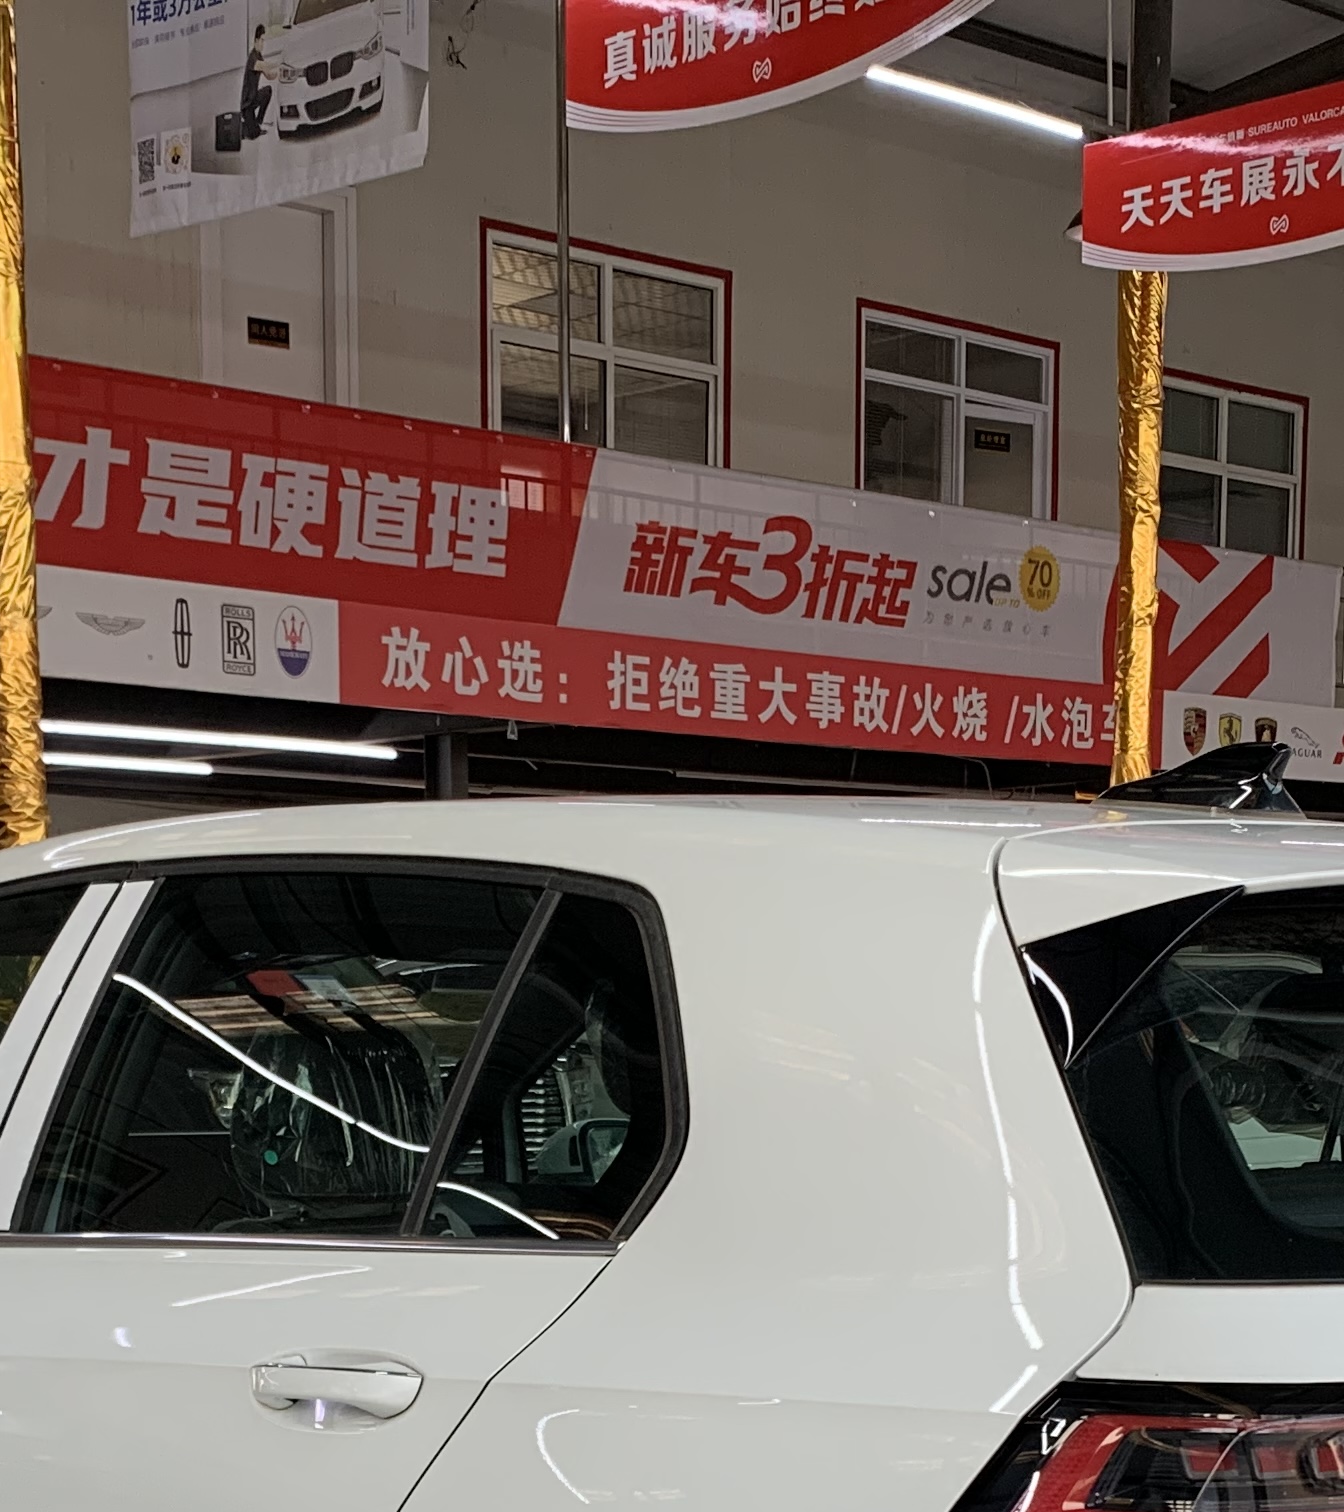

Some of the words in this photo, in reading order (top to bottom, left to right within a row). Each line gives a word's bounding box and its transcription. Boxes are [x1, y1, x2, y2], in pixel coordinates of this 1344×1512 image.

[1248, 117, 1298, 137] SUREAUTO
[623, 516, 918, 629] 新车3折起
[1028, 558, 1053, 588] 70
[927, 561, 1012, 606] sale
[225, 607, 251, 617] ROLLS
[226, 664, 251, 674] ROYCE
[1292, 747, 1322, 759] AGUAR
